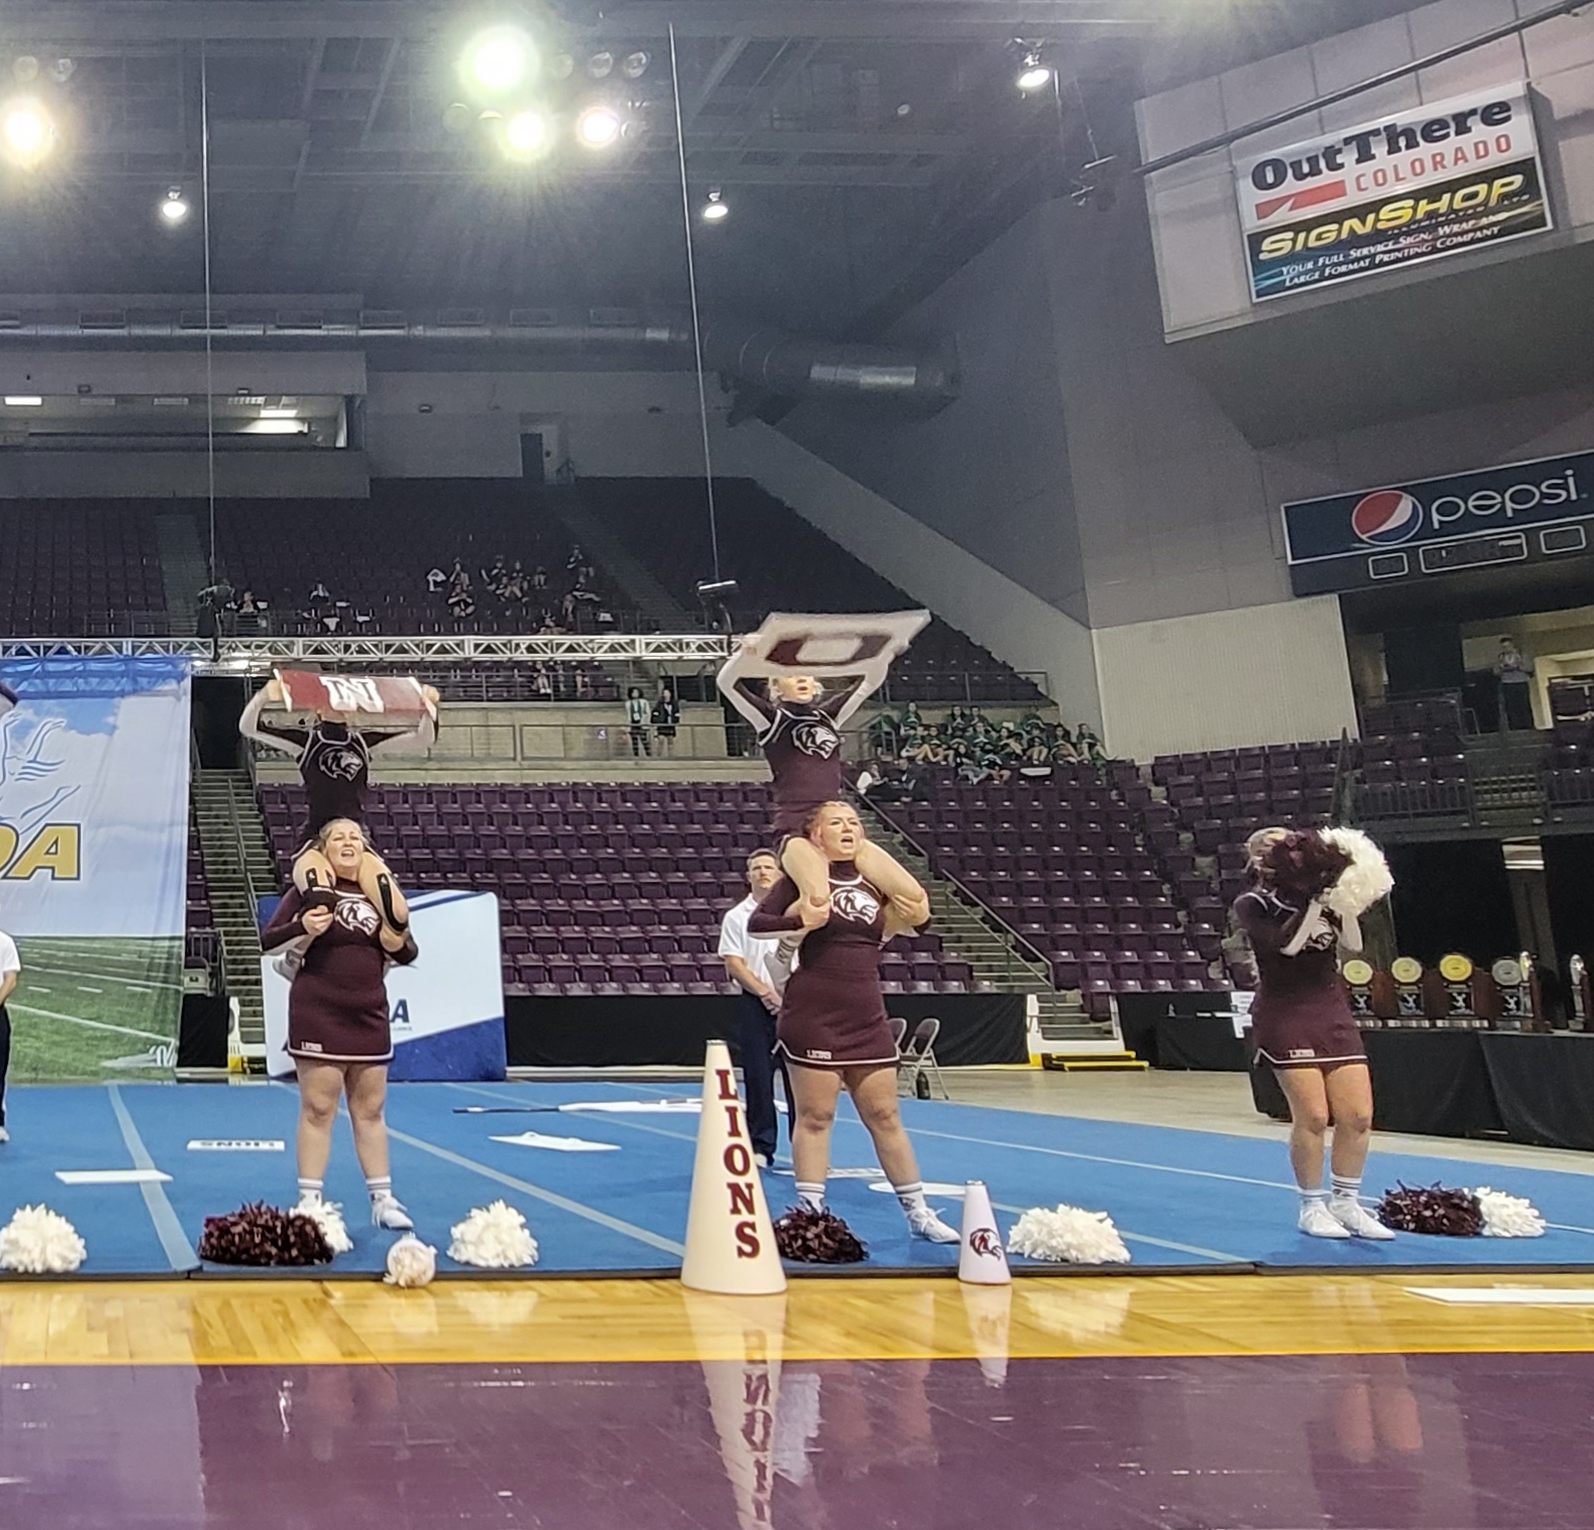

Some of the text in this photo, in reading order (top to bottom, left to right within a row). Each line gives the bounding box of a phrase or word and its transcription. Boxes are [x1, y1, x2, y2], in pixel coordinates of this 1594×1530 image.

[1356, 134, 1512, 192] COLORADO
[1281, 261, 1314, 277] YOUR
[1318, 252, 1346, 267] FULL
[1349, 240, 1396, 259] SERVICE
[1437, 217, 1474, 236] WRAP
[1284, 226, 1502, 287] LARGE FORMAT PRINTING COMPANY
[1431, 469, 1578, 530] pepsi
[318, 675, 385, 713] N
[715, 1068, 761, 1260] LIONS
